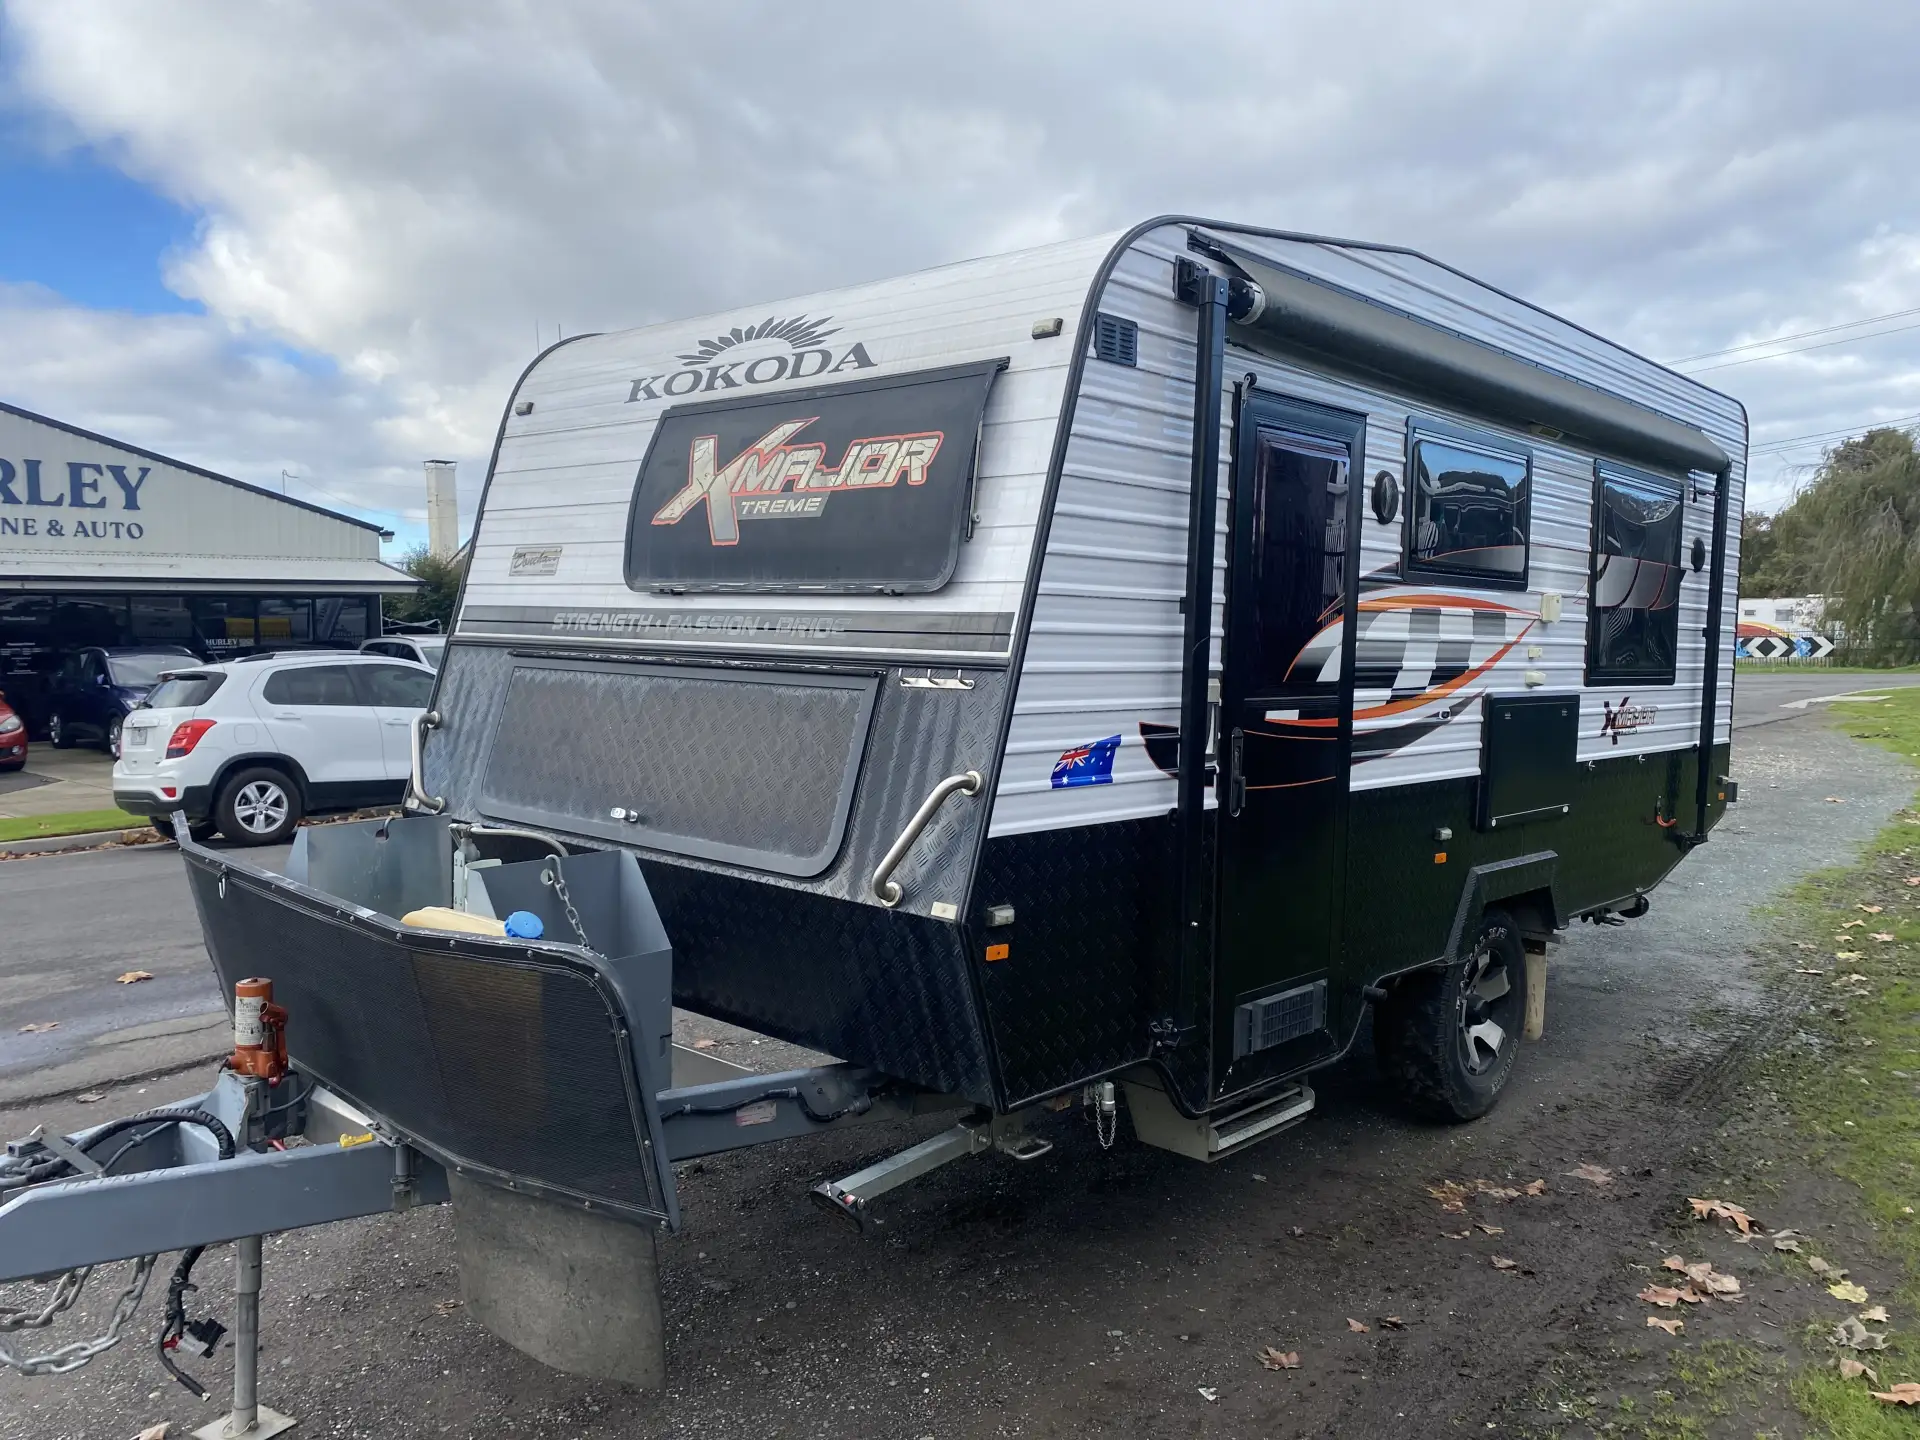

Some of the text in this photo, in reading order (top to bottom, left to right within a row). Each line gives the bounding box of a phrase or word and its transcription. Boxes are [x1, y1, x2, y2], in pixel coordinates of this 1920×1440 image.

[624, 342, 877, 403] KOKODA
[0, 517, 144, 540] NE & AUTO
[551, 612, 852, 639] STRENGTH PASSION PRIDE
[205, 638, 238, 646] HURLEY
